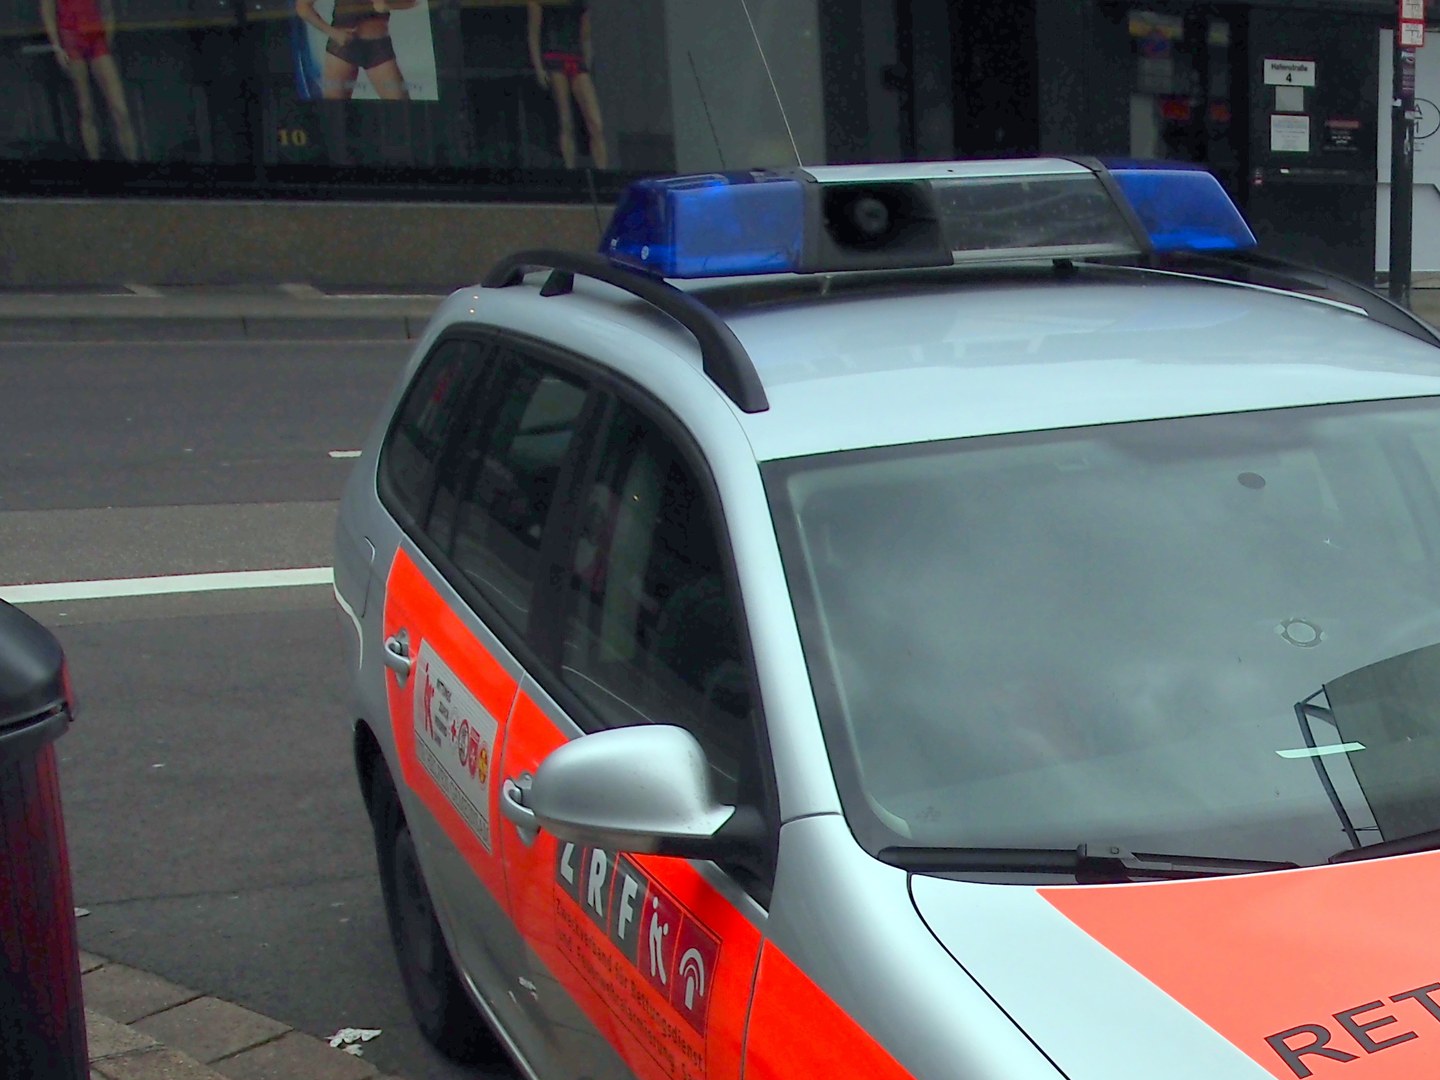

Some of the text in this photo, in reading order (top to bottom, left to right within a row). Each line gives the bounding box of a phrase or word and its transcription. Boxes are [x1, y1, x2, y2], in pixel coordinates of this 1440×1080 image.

[1285, 73, 1292, 82] 4
[278, 129, 307, 146] 10
[630, 977, 703, 1073] Rettungsdienst
